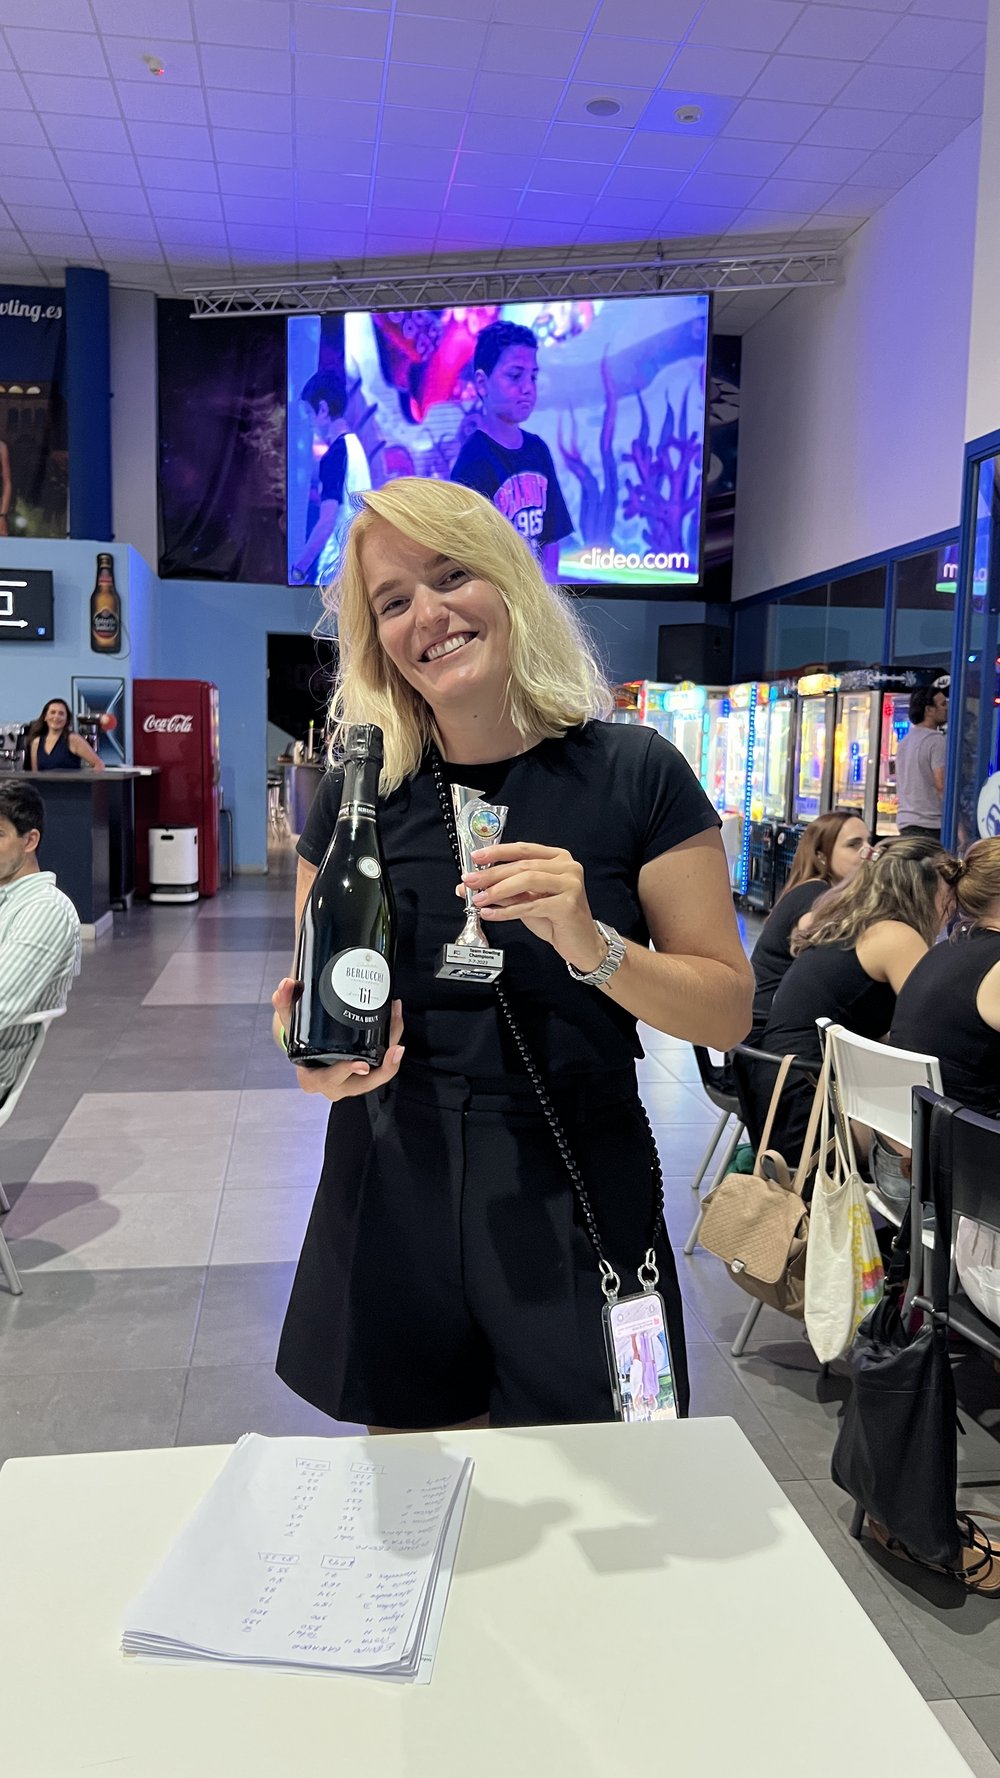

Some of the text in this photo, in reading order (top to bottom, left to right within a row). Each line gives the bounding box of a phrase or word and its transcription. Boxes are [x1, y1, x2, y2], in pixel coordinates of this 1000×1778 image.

[580, 547, 689, 569] clideo.com
[346, 967, 384, 983] BERLUCCHI
[343, 1009, 379, 1023] EXTRA BRUT
